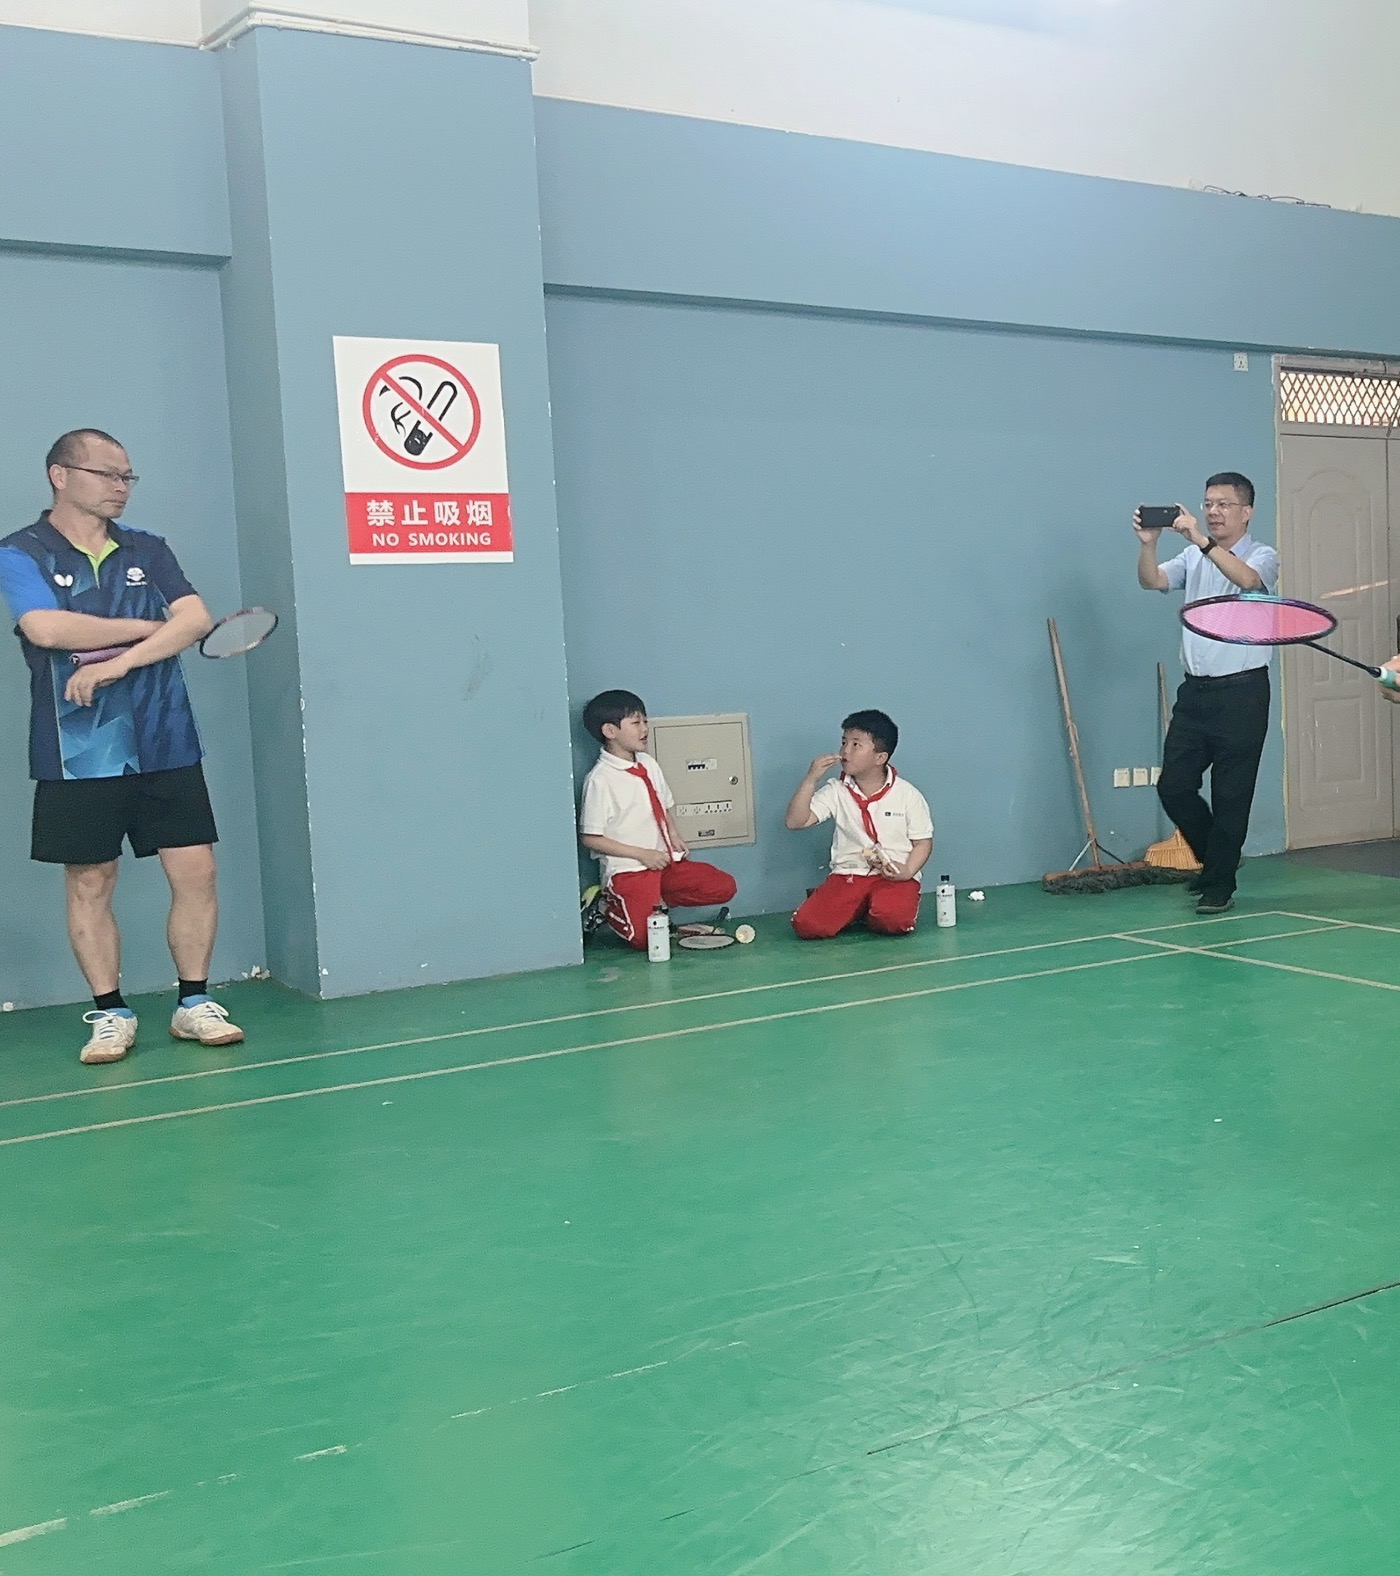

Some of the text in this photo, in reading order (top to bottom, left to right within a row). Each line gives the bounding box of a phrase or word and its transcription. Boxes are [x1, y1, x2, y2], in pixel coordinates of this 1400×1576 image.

[366, 499, 493, 526] 禁止吸烟
[372, 532, 491, 546] NO SMOKING
